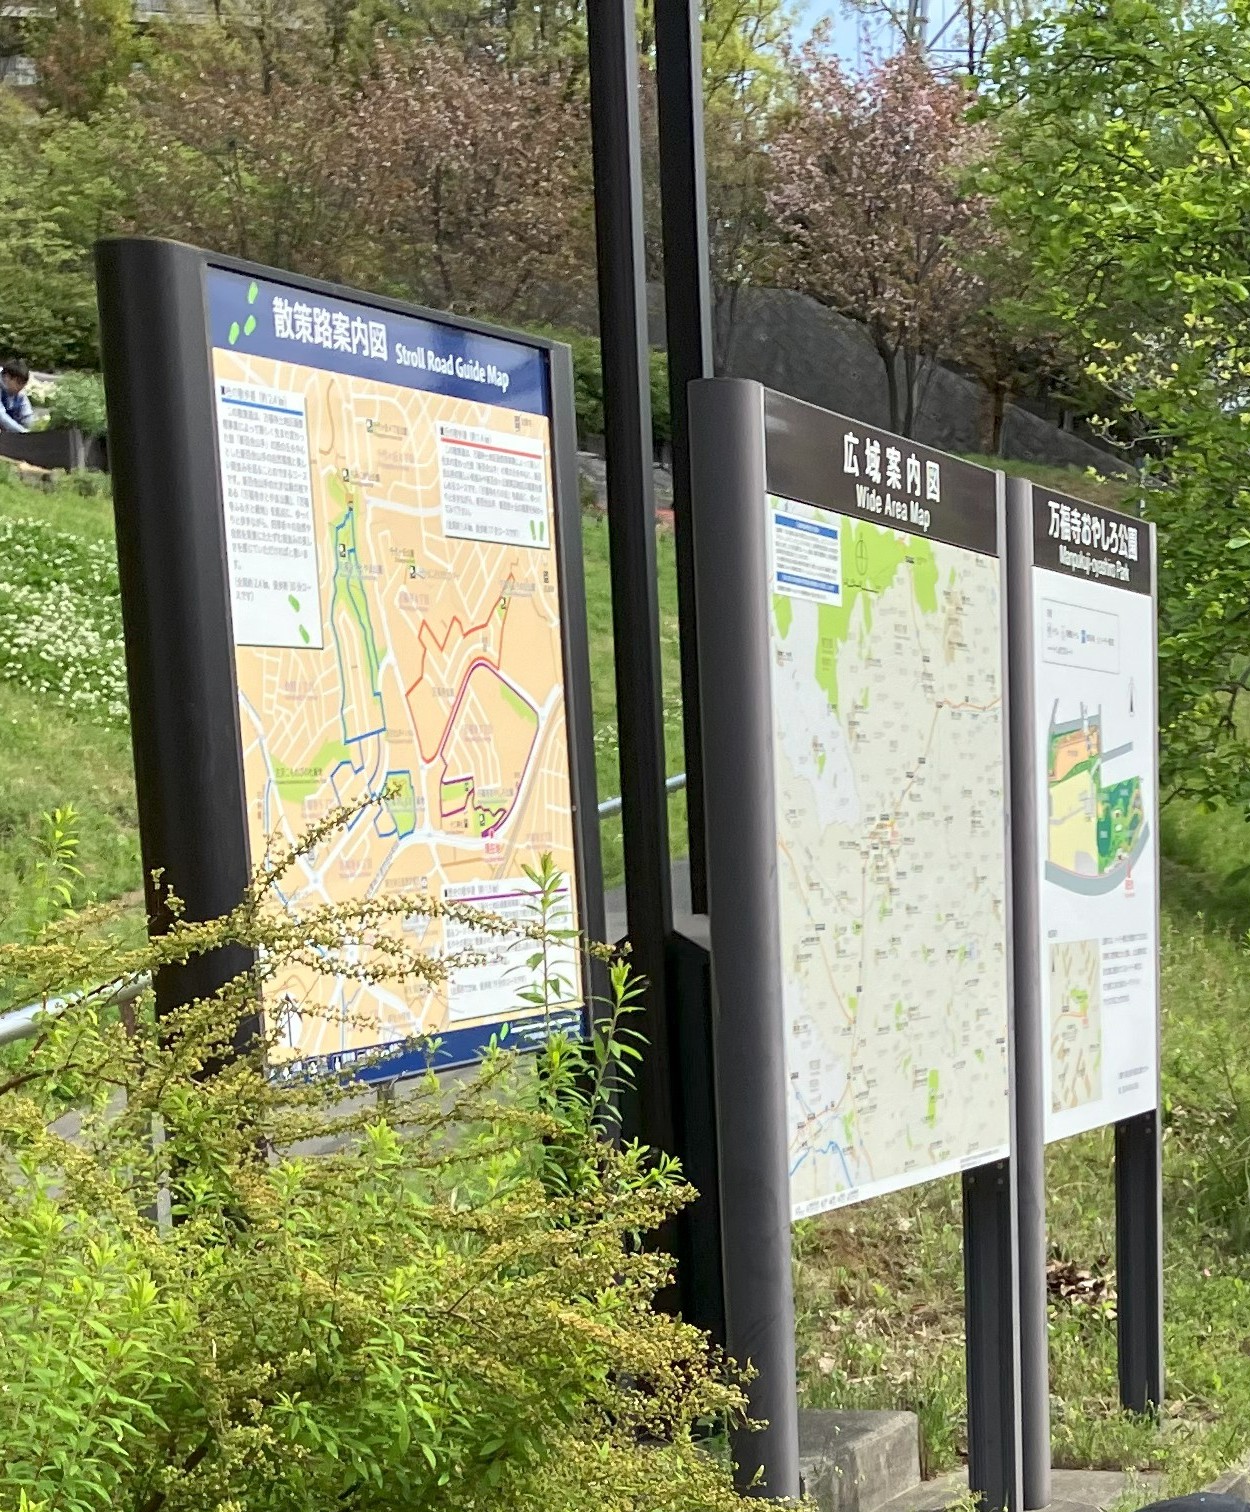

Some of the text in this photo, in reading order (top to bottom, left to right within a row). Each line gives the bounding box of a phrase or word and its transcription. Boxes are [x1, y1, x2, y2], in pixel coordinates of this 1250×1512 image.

[272, 296, 388, 361] 散策路案内図
[395, 343, 509, 393] Stroll Road Guide Map
[843, 431, 940, 503] 広域案内図
[856, 483, 931, 532] Wide Area Map
[1047, 500, 1138, 562] 万福寺おやしろ公園
